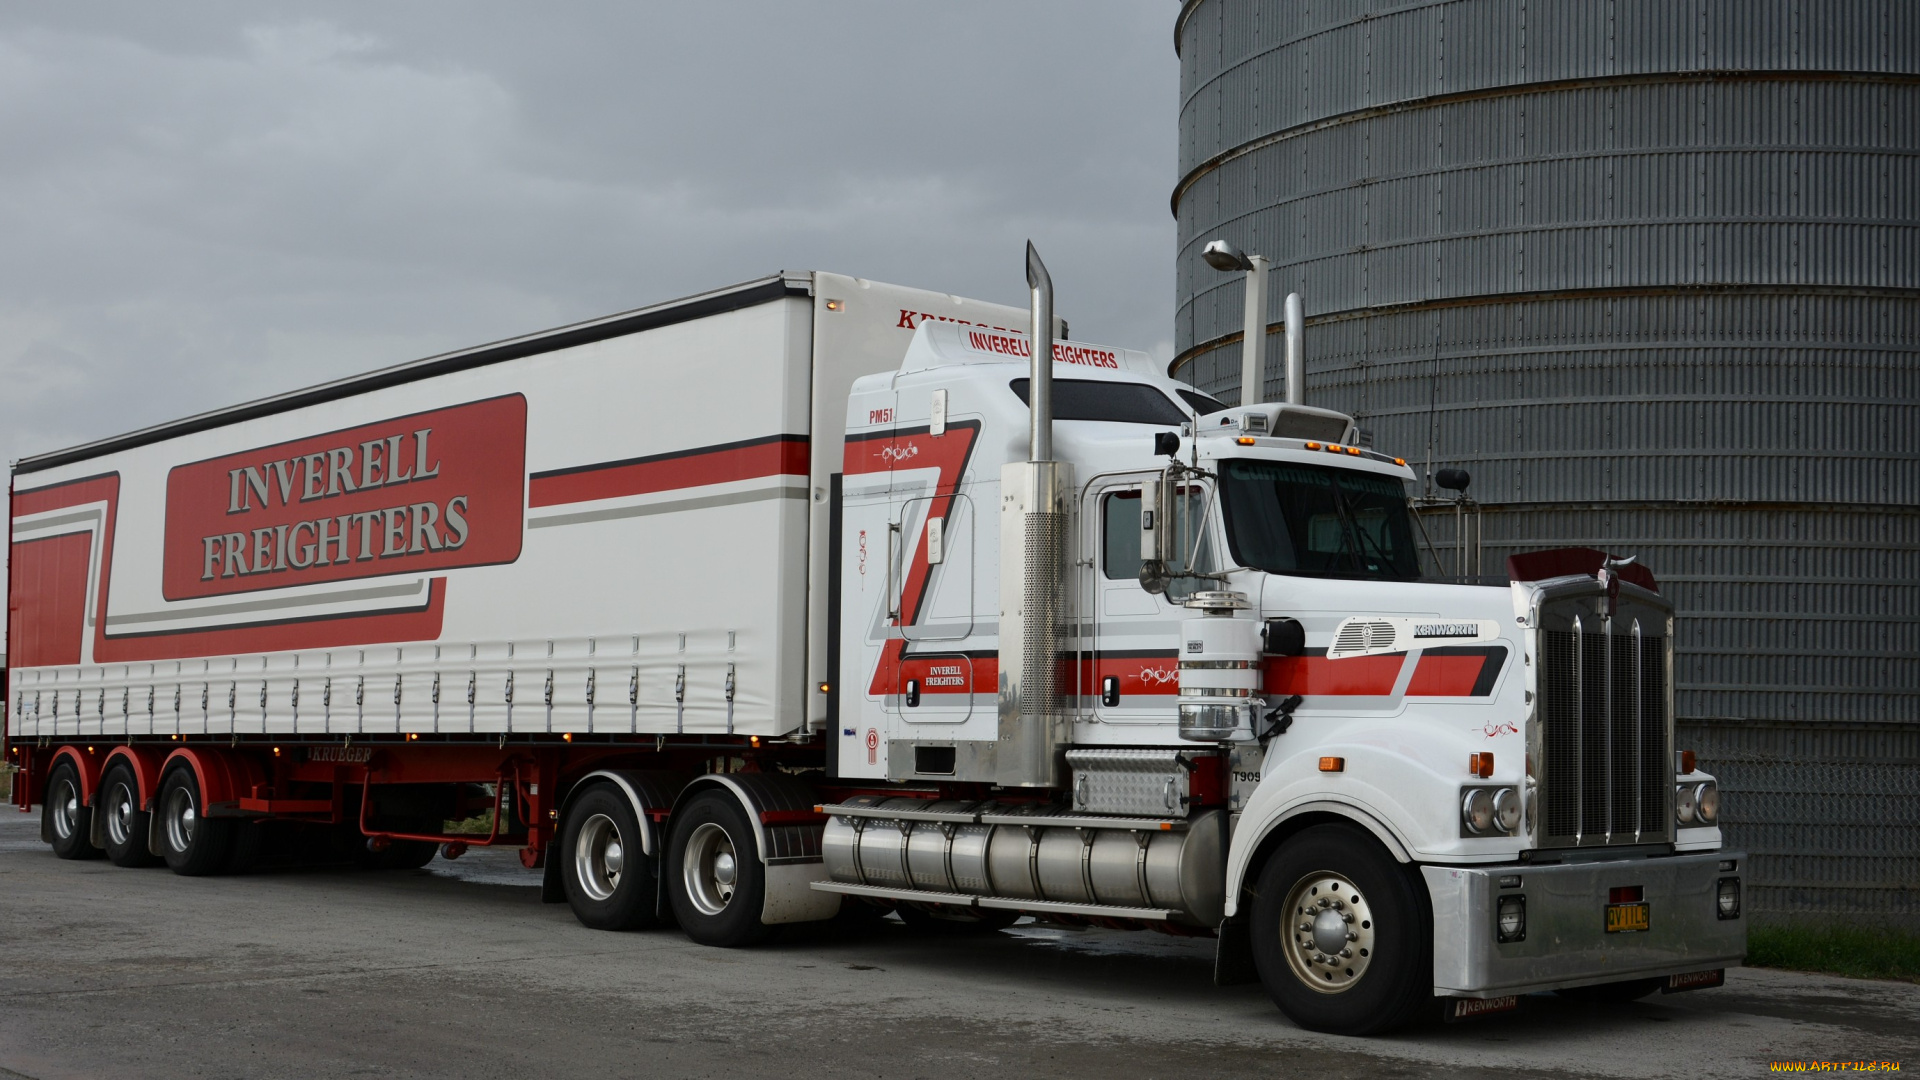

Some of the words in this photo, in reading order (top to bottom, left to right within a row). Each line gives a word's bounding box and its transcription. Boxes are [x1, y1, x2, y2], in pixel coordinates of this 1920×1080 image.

[1052, 344, 1118, 369] EIGHTERS
[869, 408, 893, 425] PM51
[226, 429, 440, 514] INVERELL
[201, 496, 468, 579] FREIGHTERS
[1414, 624, 1478, 636] KENWORTH
[930, 666, 962, 675] INVERELL
[925, 677, 964, 686] FREIGHTERS
[312, 746, 371, 762] KRUEGER
[1233, 771, 1260, 783] T909
[1678, 970, 1717, 984] KENWORTH
[1467, 995, 1516, 1013] KENWORTH
